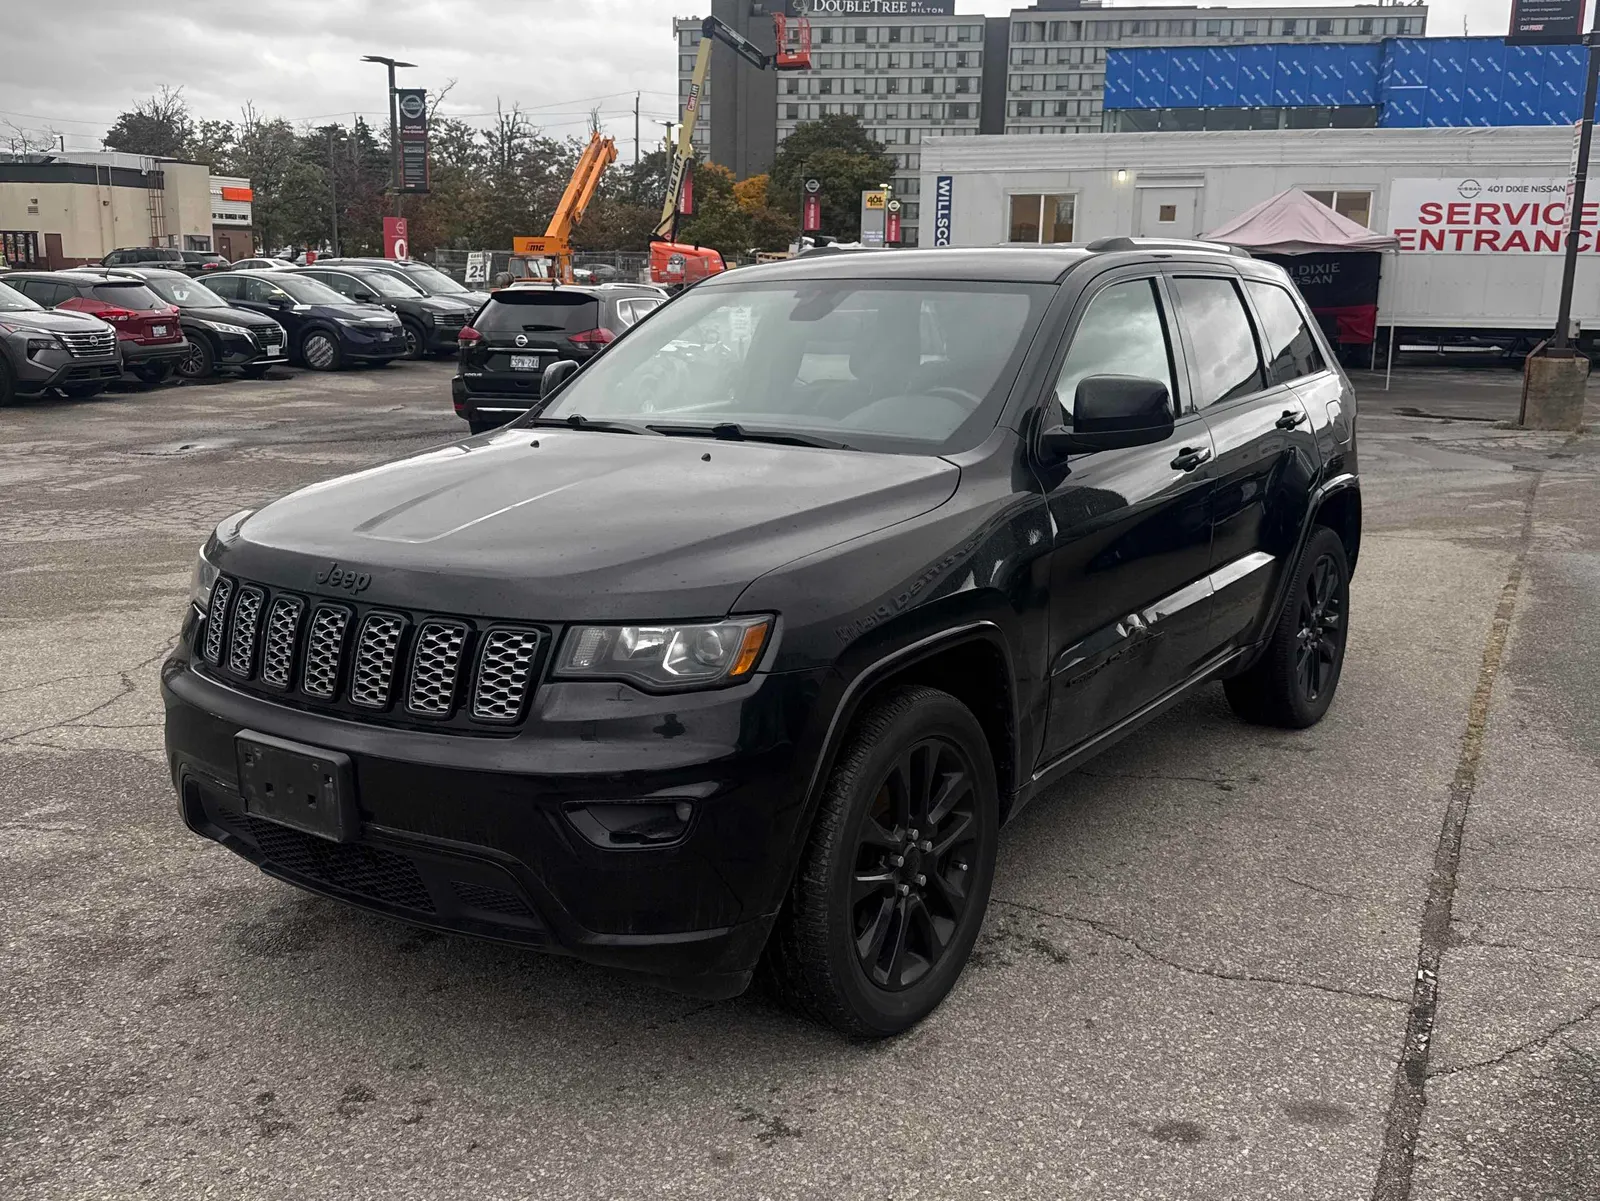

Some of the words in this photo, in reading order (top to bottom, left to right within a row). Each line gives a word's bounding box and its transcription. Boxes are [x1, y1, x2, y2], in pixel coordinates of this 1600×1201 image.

[1487, 185, 1503, 193] 401
[1506, 185, 1529, 193] DIXIE
[1531, 185, 1566, 193] NISSAN
[936, 180, 951, 247] WILLSCO
[1418, 202, 1600, 226] SERVICE
[1393, 229, 1600, 253] ENTRANC
[1299, 262, 1341, 275] DIXIE
[316, 561, 372, 596] Jeep
